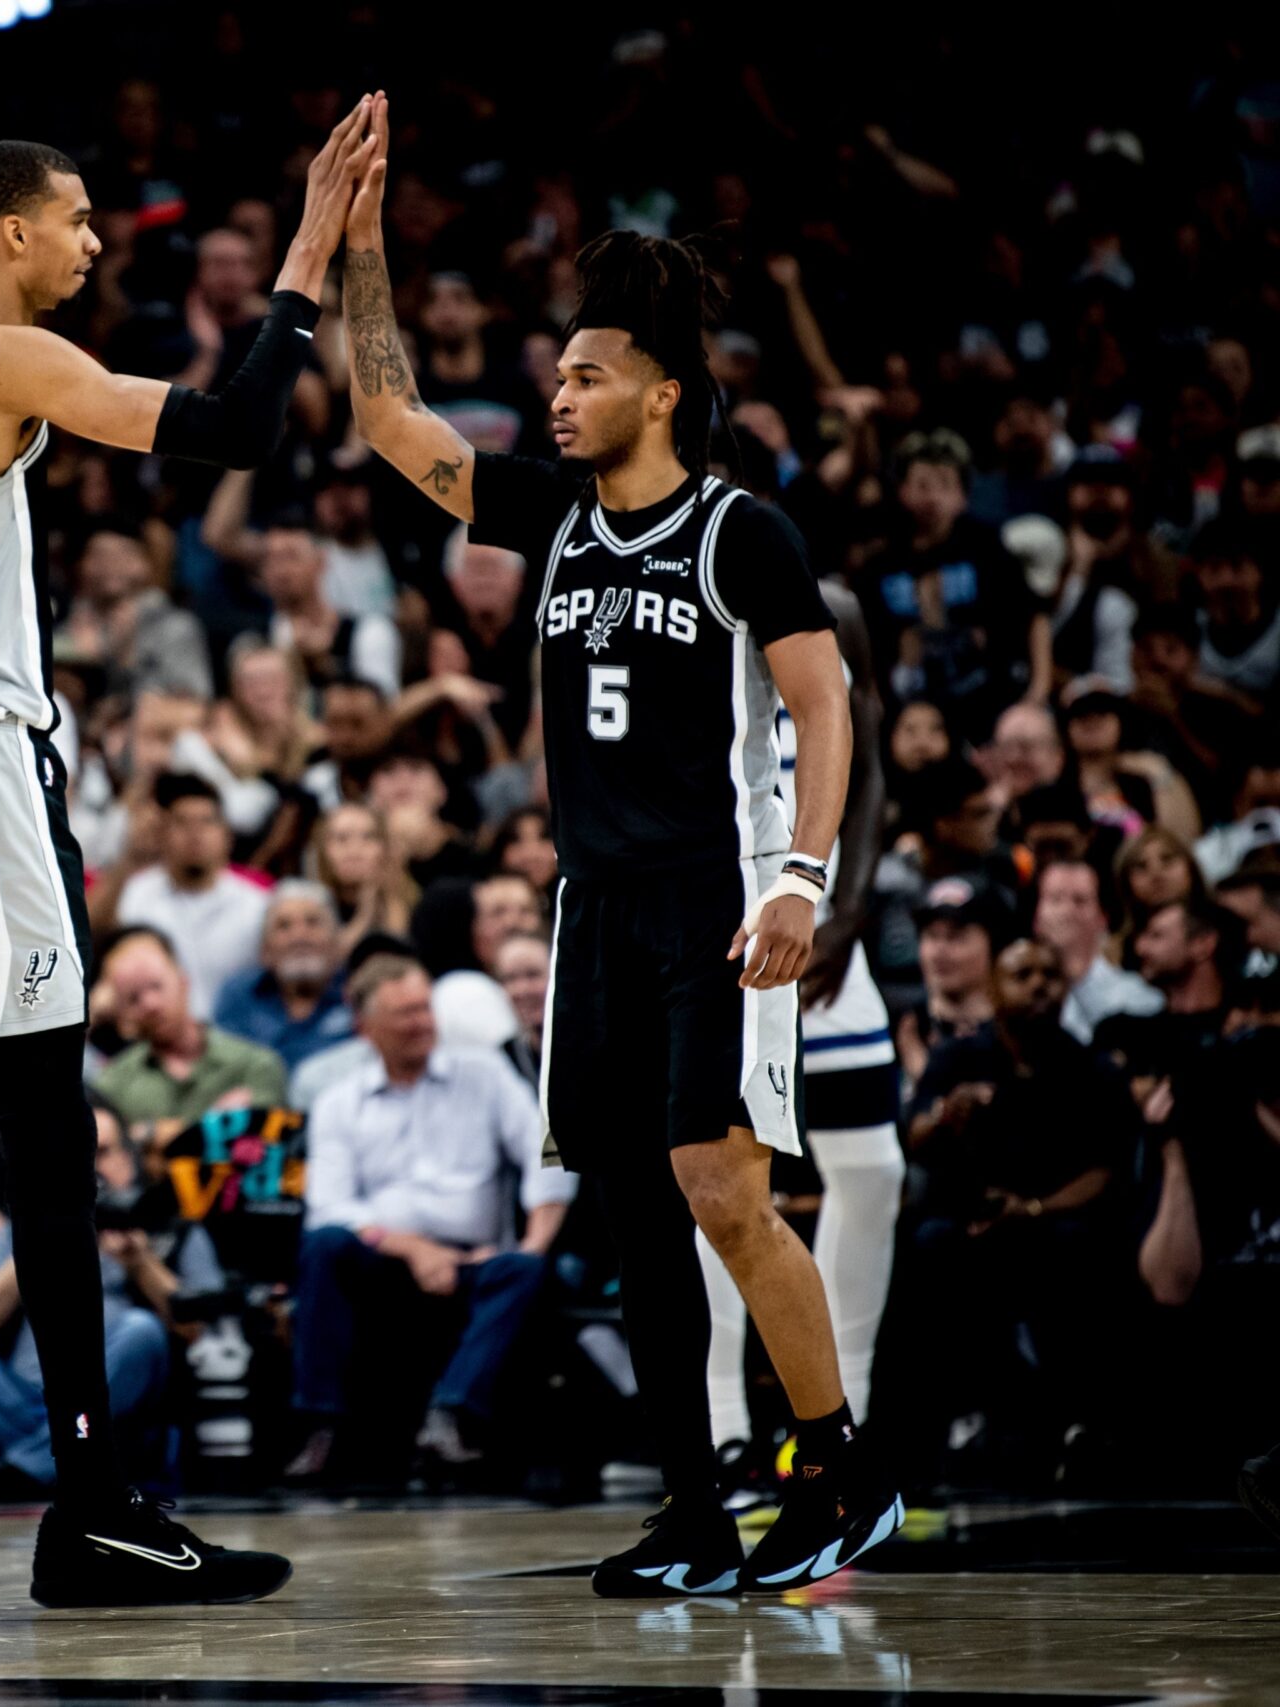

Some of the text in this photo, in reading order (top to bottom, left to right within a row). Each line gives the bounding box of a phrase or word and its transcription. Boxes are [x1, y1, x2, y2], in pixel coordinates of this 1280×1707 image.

[648, 560, 684, 572] LEDGER
[547, 587, 699, 655] SPURS
[587, 664, 630, 741] 5
